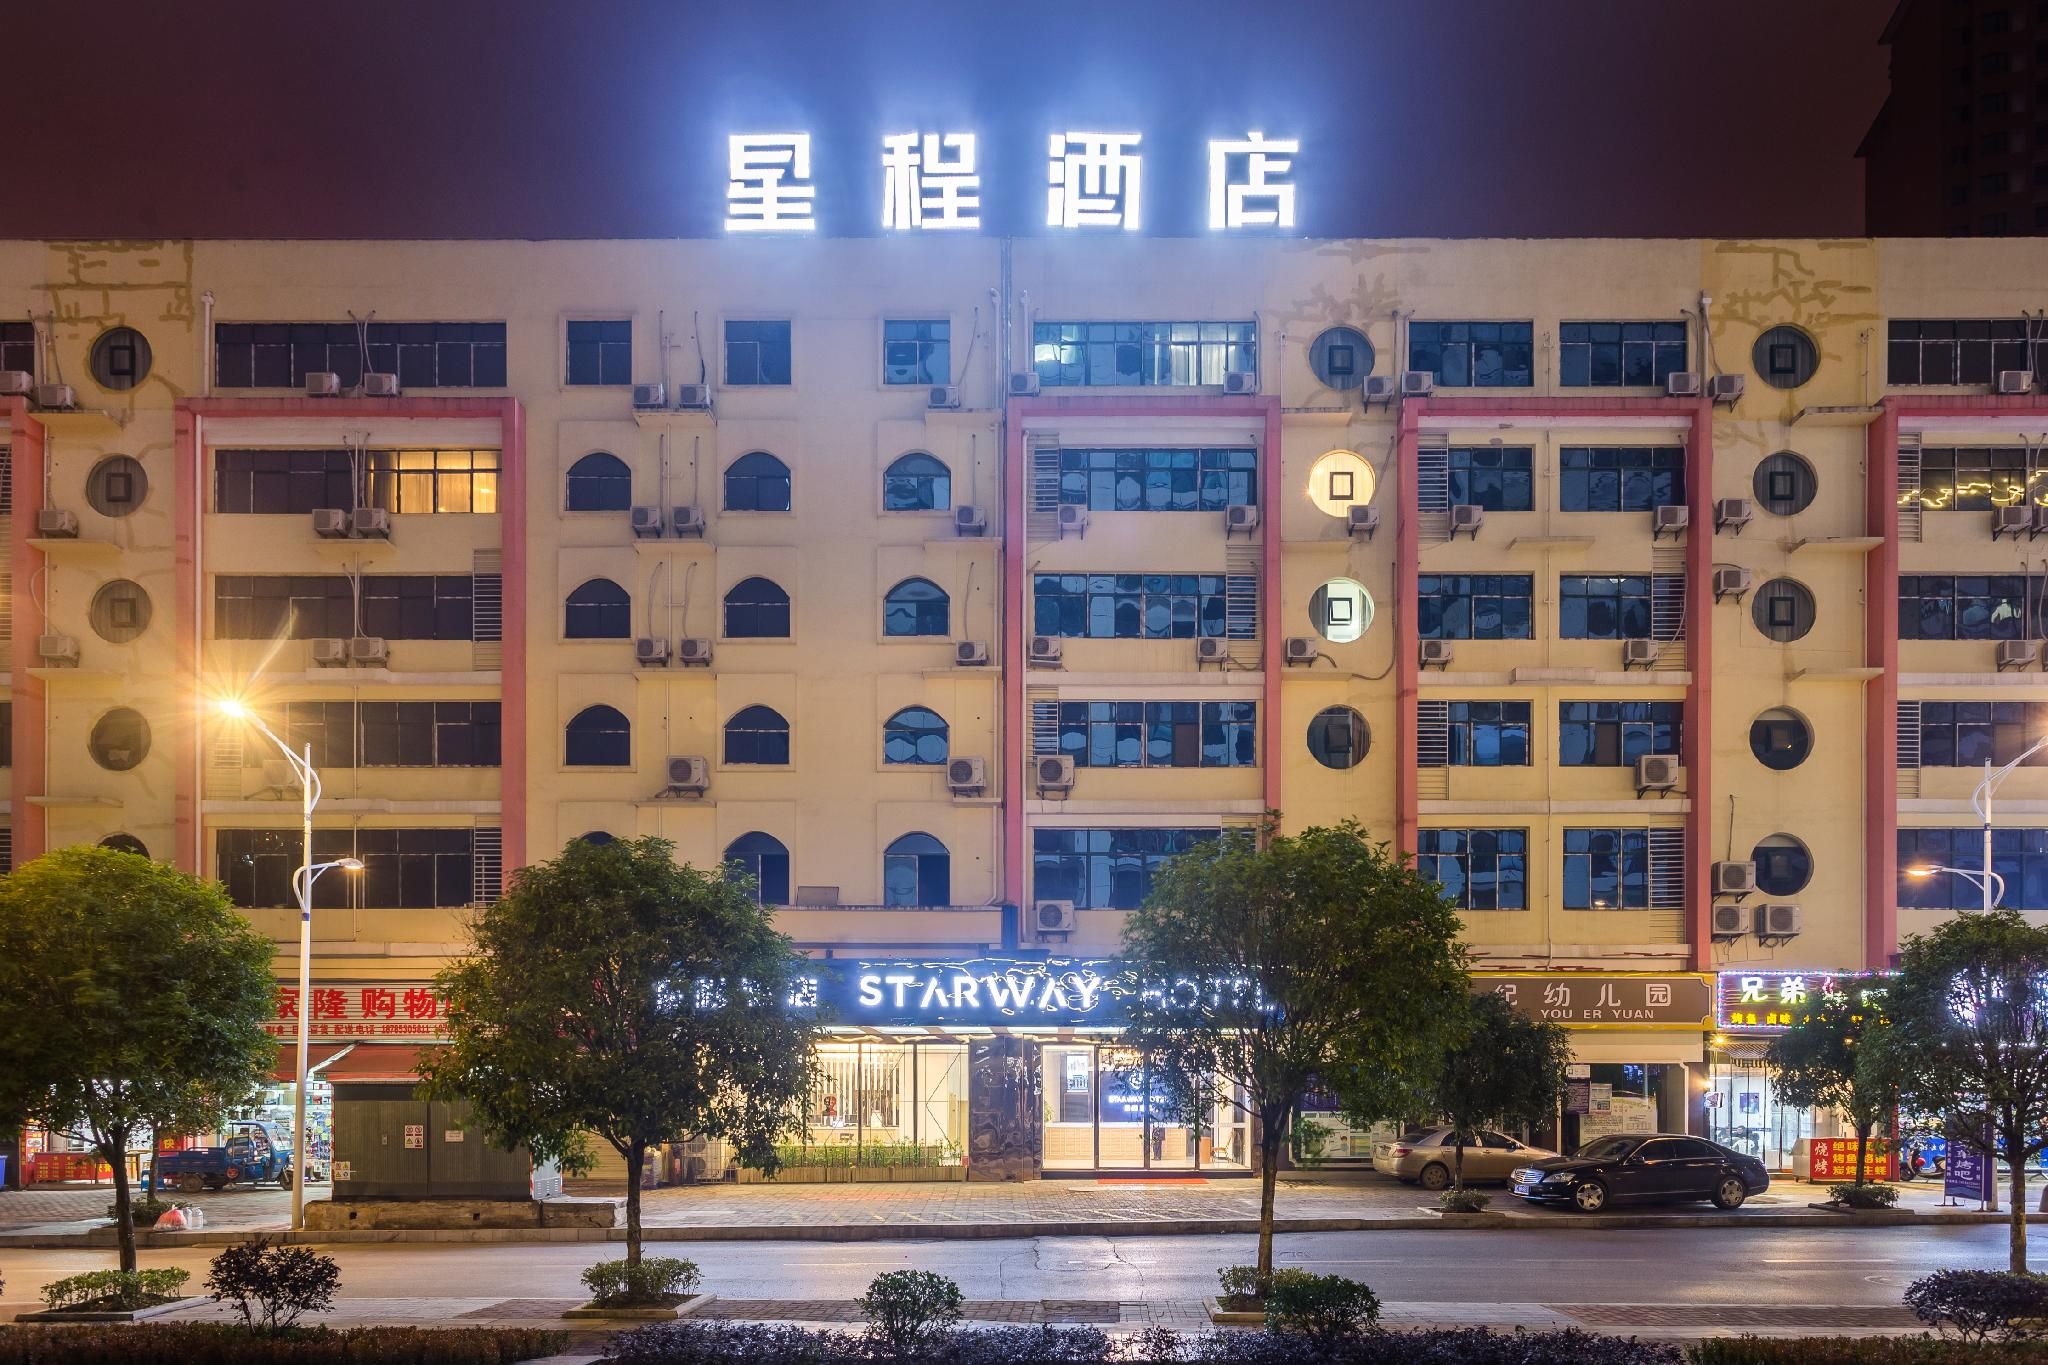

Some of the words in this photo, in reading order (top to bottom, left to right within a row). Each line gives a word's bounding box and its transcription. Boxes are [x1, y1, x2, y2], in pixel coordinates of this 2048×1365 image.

[725, 131, 1299, 230] 星程酒店
[860, 976, 1100, 1008] STARWAY
[1541, 1009, 1573, 1019] YOU
[1583, 1009, 1602, 1019] ER
[1612, 1009, 1654, 1019] YUAN
[1815, 1142, 1829, 1175] 烧烤
